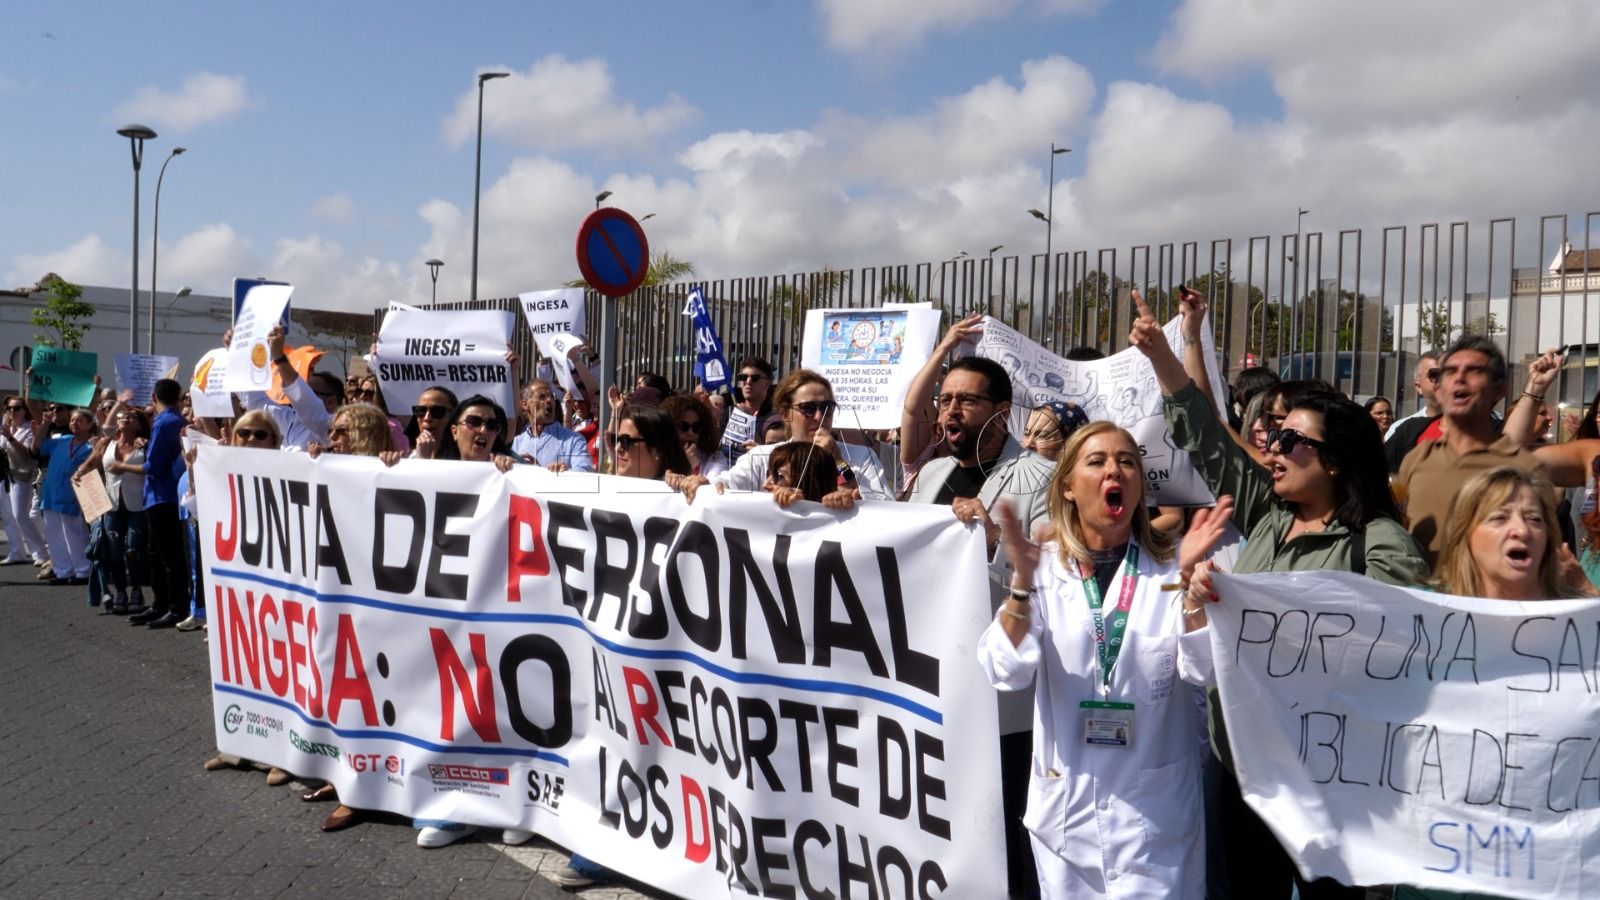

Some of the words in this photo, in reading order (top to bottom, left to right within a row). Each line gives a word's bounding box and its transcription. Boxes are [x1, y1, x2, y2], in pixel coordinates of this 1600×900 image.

[526, 299, 569, 312] INGESA
[532, 321, 571, 335] MIENTE
[404, 338, 461, 357] INGESA
[36, 350, 57, 363] SIN
[825, 368, 849, 376] INGESA
[850, 368, 861, 376] NO
[861, 368, 892, 376] NEGOCIA
[875, 377, 889, 385] LAS
[835, 386, 860, 394] IMPONE
[861, 386, 867, 394] A
[867, 386, 878, 394] SU
[834, 395, 851, 403] ERA.
[852, 395, 889, 403] QUEREMOS
[215, 473, 352, 586] JUNTA
[372, 487, 481, 600] DE
[507, 493, 940, 698] PERSONAL
[1236, 608, 1355, 678] POR
[1365, 612, 1479, 685] UNA
[1506, 616, 1600, 693] SA
[214, 584, 396, 728] INGESA:
[429, 626, 573, 749] NO
[592, 644, 629, 740] AL
[622, 665, 860, 808] RECORTE
[877, 714, 952, 841] DE
[1291, 702, 1446, 801] BLICA
[1464, 728, 1540, 812] DE
[448, 767, 491, 781] CCOO
[598, 746, 674, 850] LOS
[1423, 821, 1536, 881] SMM
